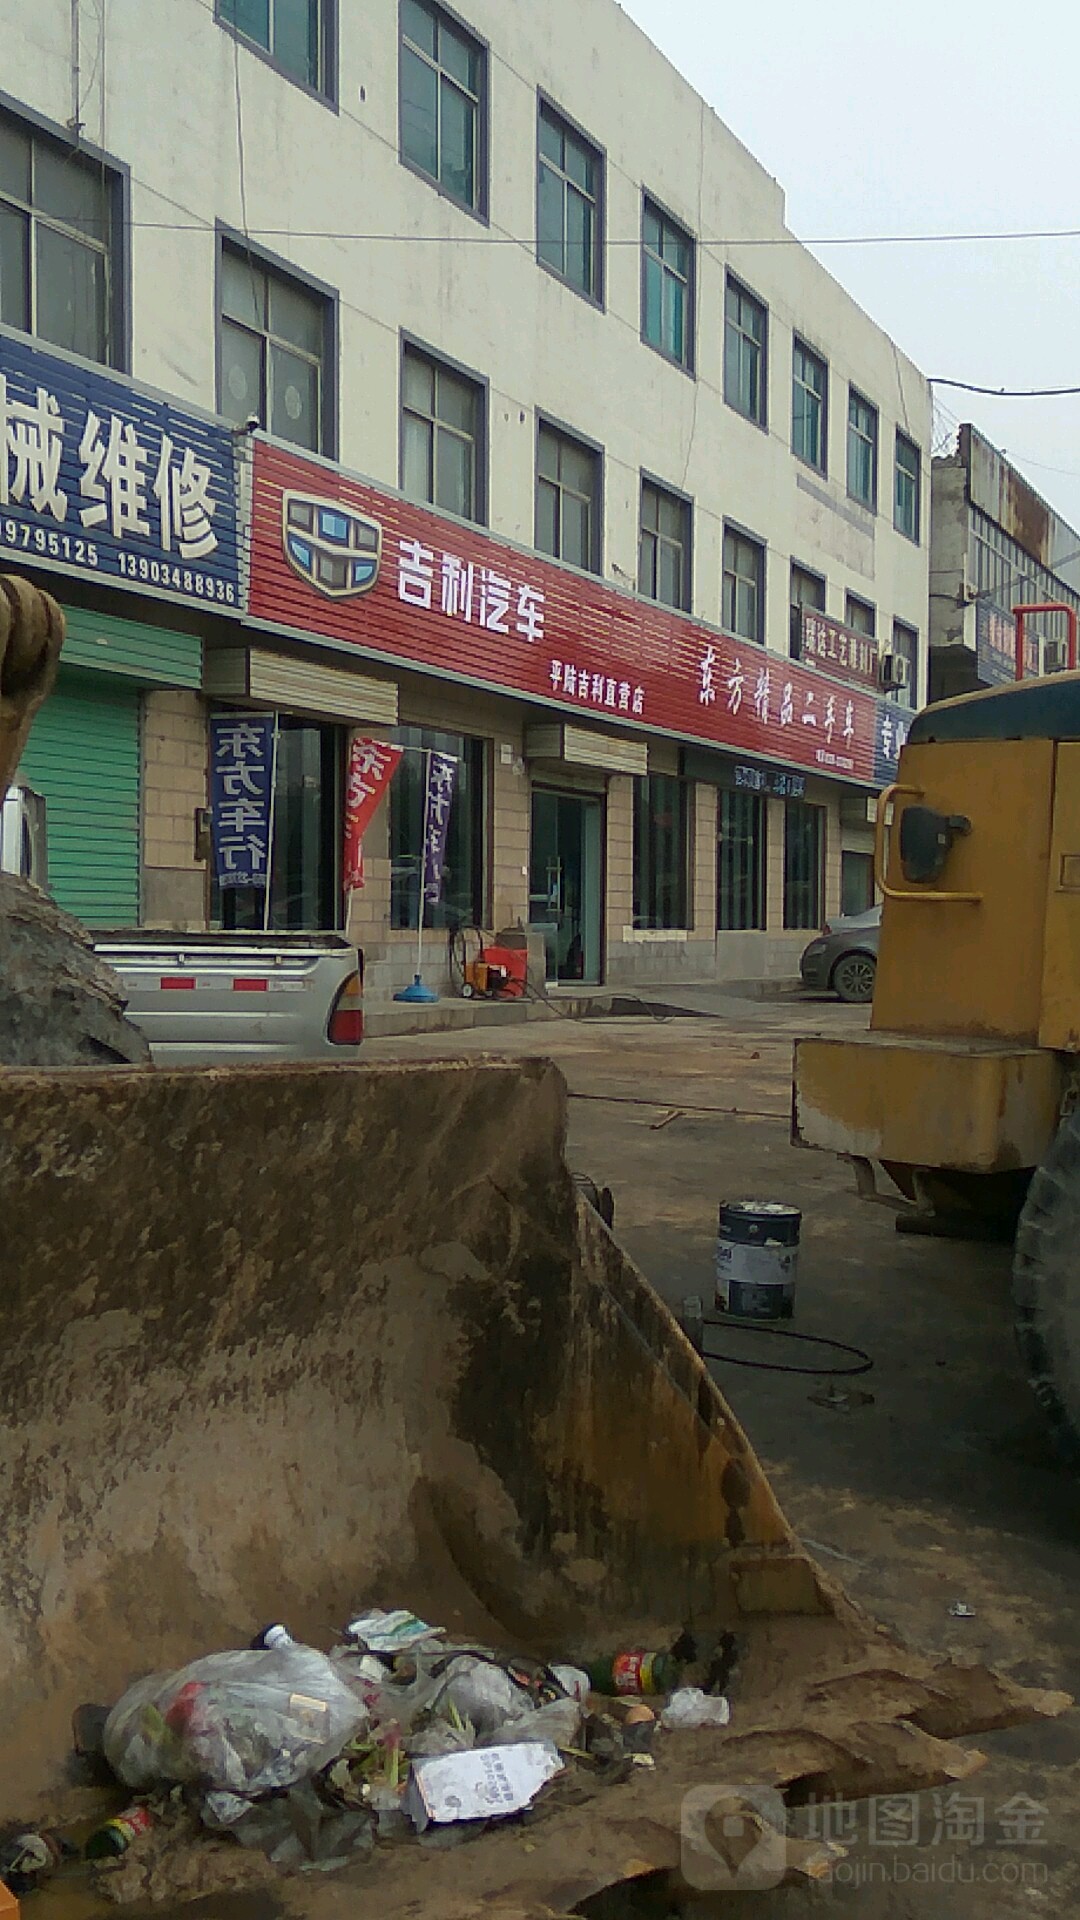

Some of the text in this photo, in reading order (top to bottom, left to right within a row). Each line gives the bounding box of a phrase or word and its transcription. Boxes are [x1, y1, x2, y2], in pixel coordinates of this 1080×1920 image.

[0, 520, 235, 603] 9795125 13903488936
[397, 539, 546, 643] 吉利汽车
[549, 659, 645, 715] 平陆吉利直营店
